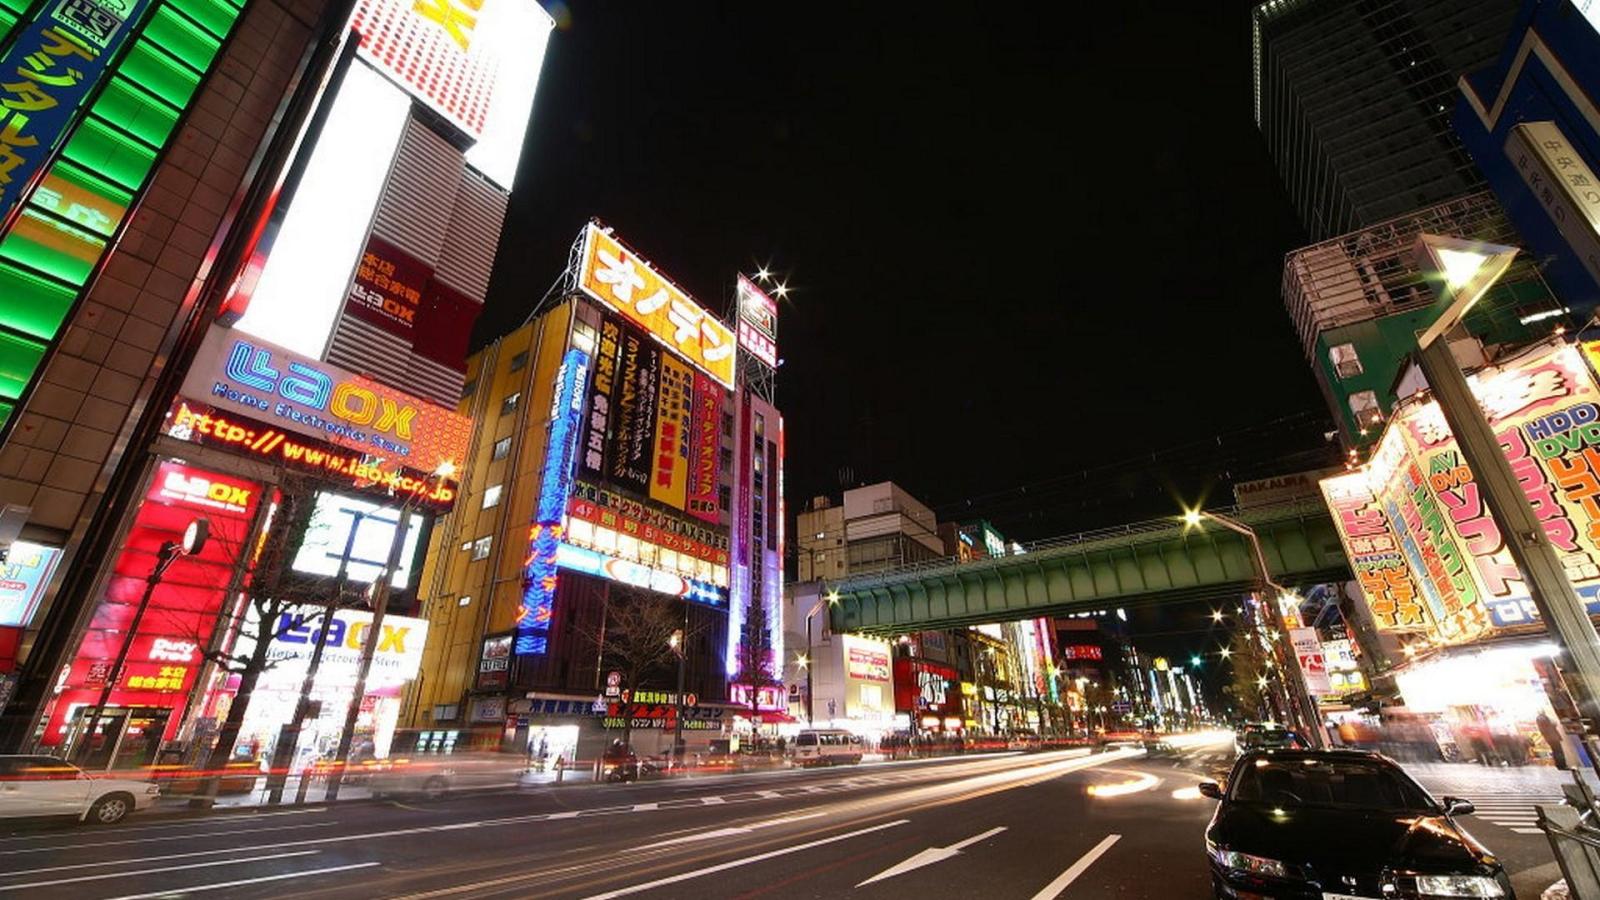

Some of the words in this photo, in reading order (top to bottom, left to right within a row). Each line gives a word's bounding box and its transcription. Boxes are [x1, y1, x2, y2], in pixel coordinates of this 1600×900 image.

[595, 247, 732, 362] オノデン
[212, 382, 269, 411] Home
[274, 402, 366, 443] Electronics
[371, 432, 410, 456] Store
[226, 341, 417, 440] Laox
[1524, 403, 1598, 441] HDD
[1430, 451, 1456, 475] AV
[1430, 465, 1473, 492] DVD
[1438, 482, 1522, 596] ソフト
